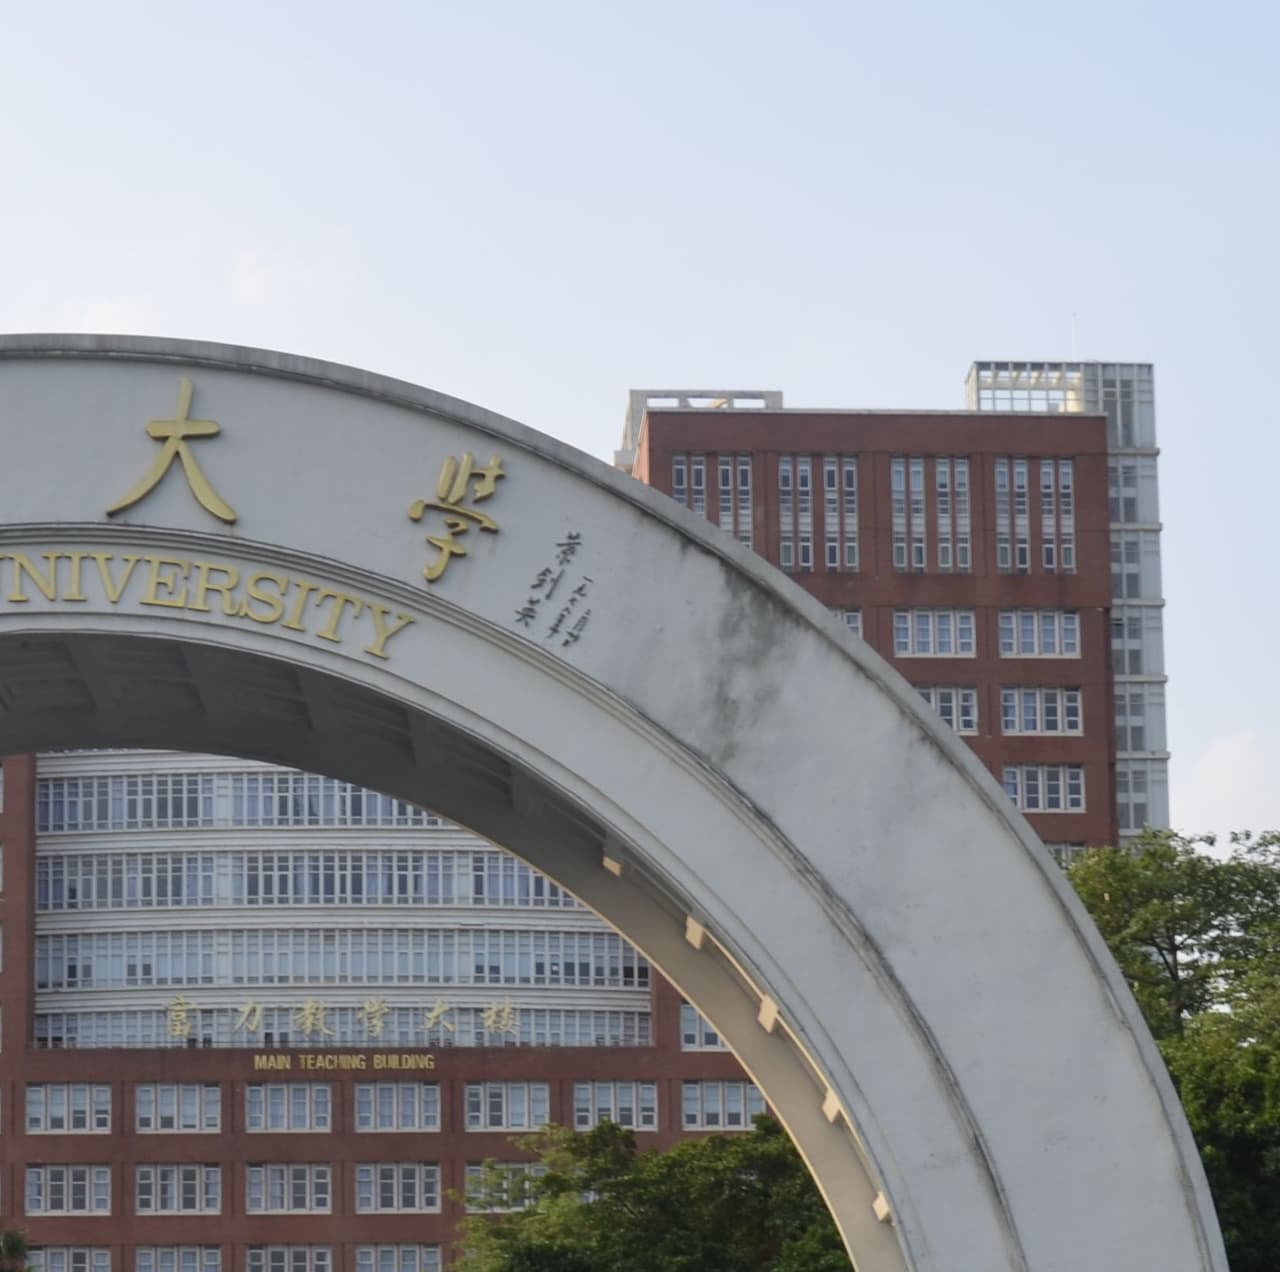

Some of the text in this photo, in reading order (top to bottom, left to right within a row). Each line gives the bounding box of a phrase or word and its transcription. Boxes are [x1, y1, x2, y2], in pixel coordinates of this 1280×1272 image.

[254, 1053, 435, 1071] MAIN TEACHING BUILDING
